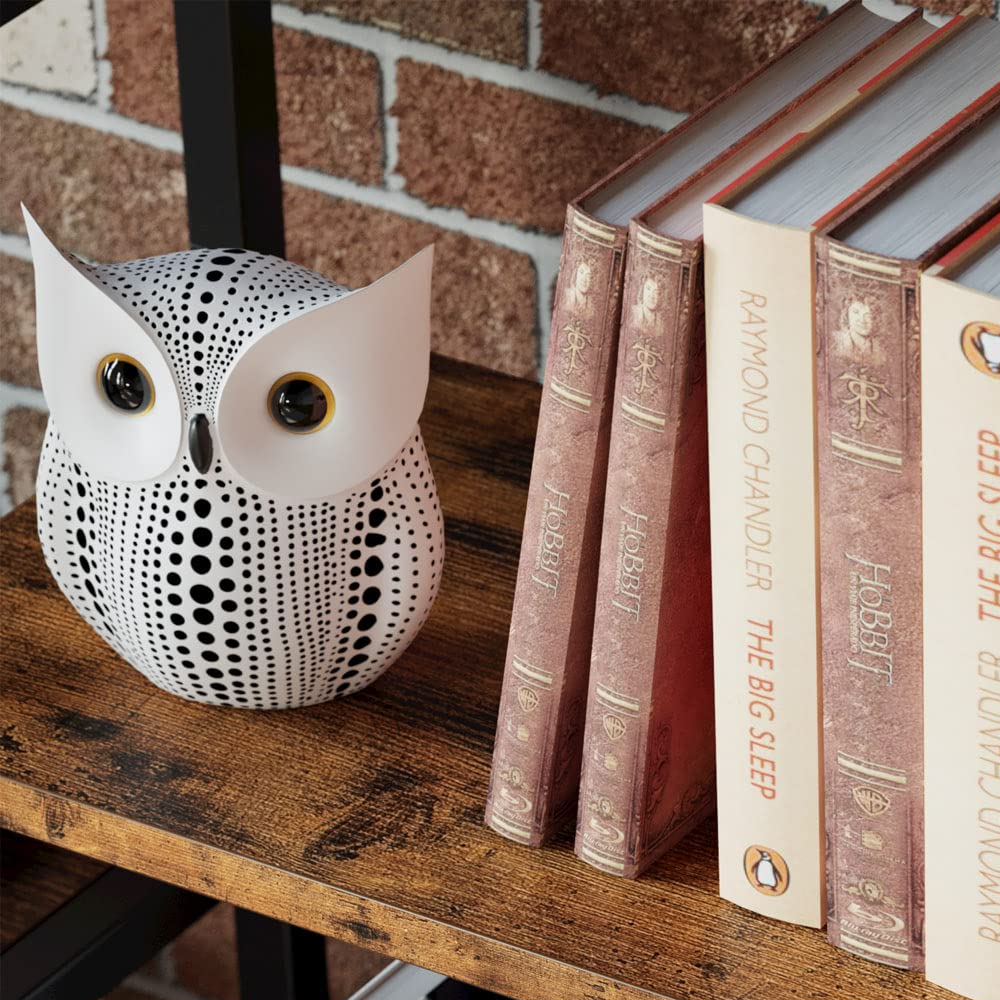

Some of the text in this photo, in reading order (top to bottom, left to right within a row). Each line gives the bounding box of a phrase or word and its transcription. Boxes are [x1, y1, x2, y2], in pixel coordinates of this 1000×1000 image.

[739, 290, 773, 591] RAYMOND CHANDLER
[531, 481, 571, 599] HOBBIT
[611, 503, 648, 625] HOBBIT
[845, 552, 893, 686] HOBBIT
[747, 618, 776, 800] THE BIG SLEEP
